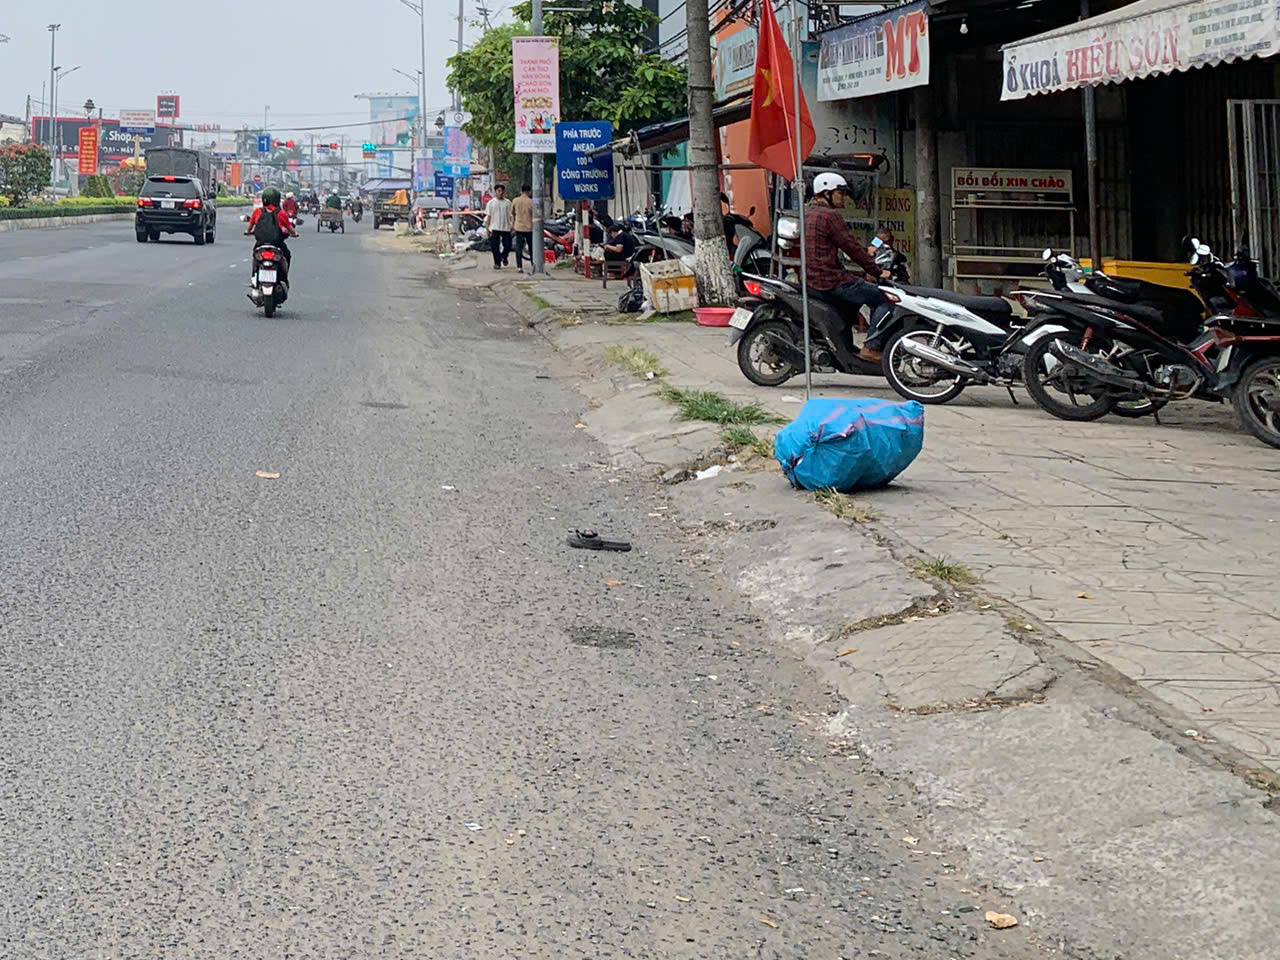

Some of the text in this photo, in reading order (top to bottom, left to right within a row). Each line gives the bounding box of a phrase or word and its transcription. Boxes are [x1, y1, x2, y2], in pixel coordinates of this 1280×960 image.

[884, 8, 925, 81] MT
[572, 143, 595, 152] AHEAD
[561, 168, 580, 179] CÔNG
[1006, 177, 1028, 187] XIN
[573, 183, 599, 192] WORKS
